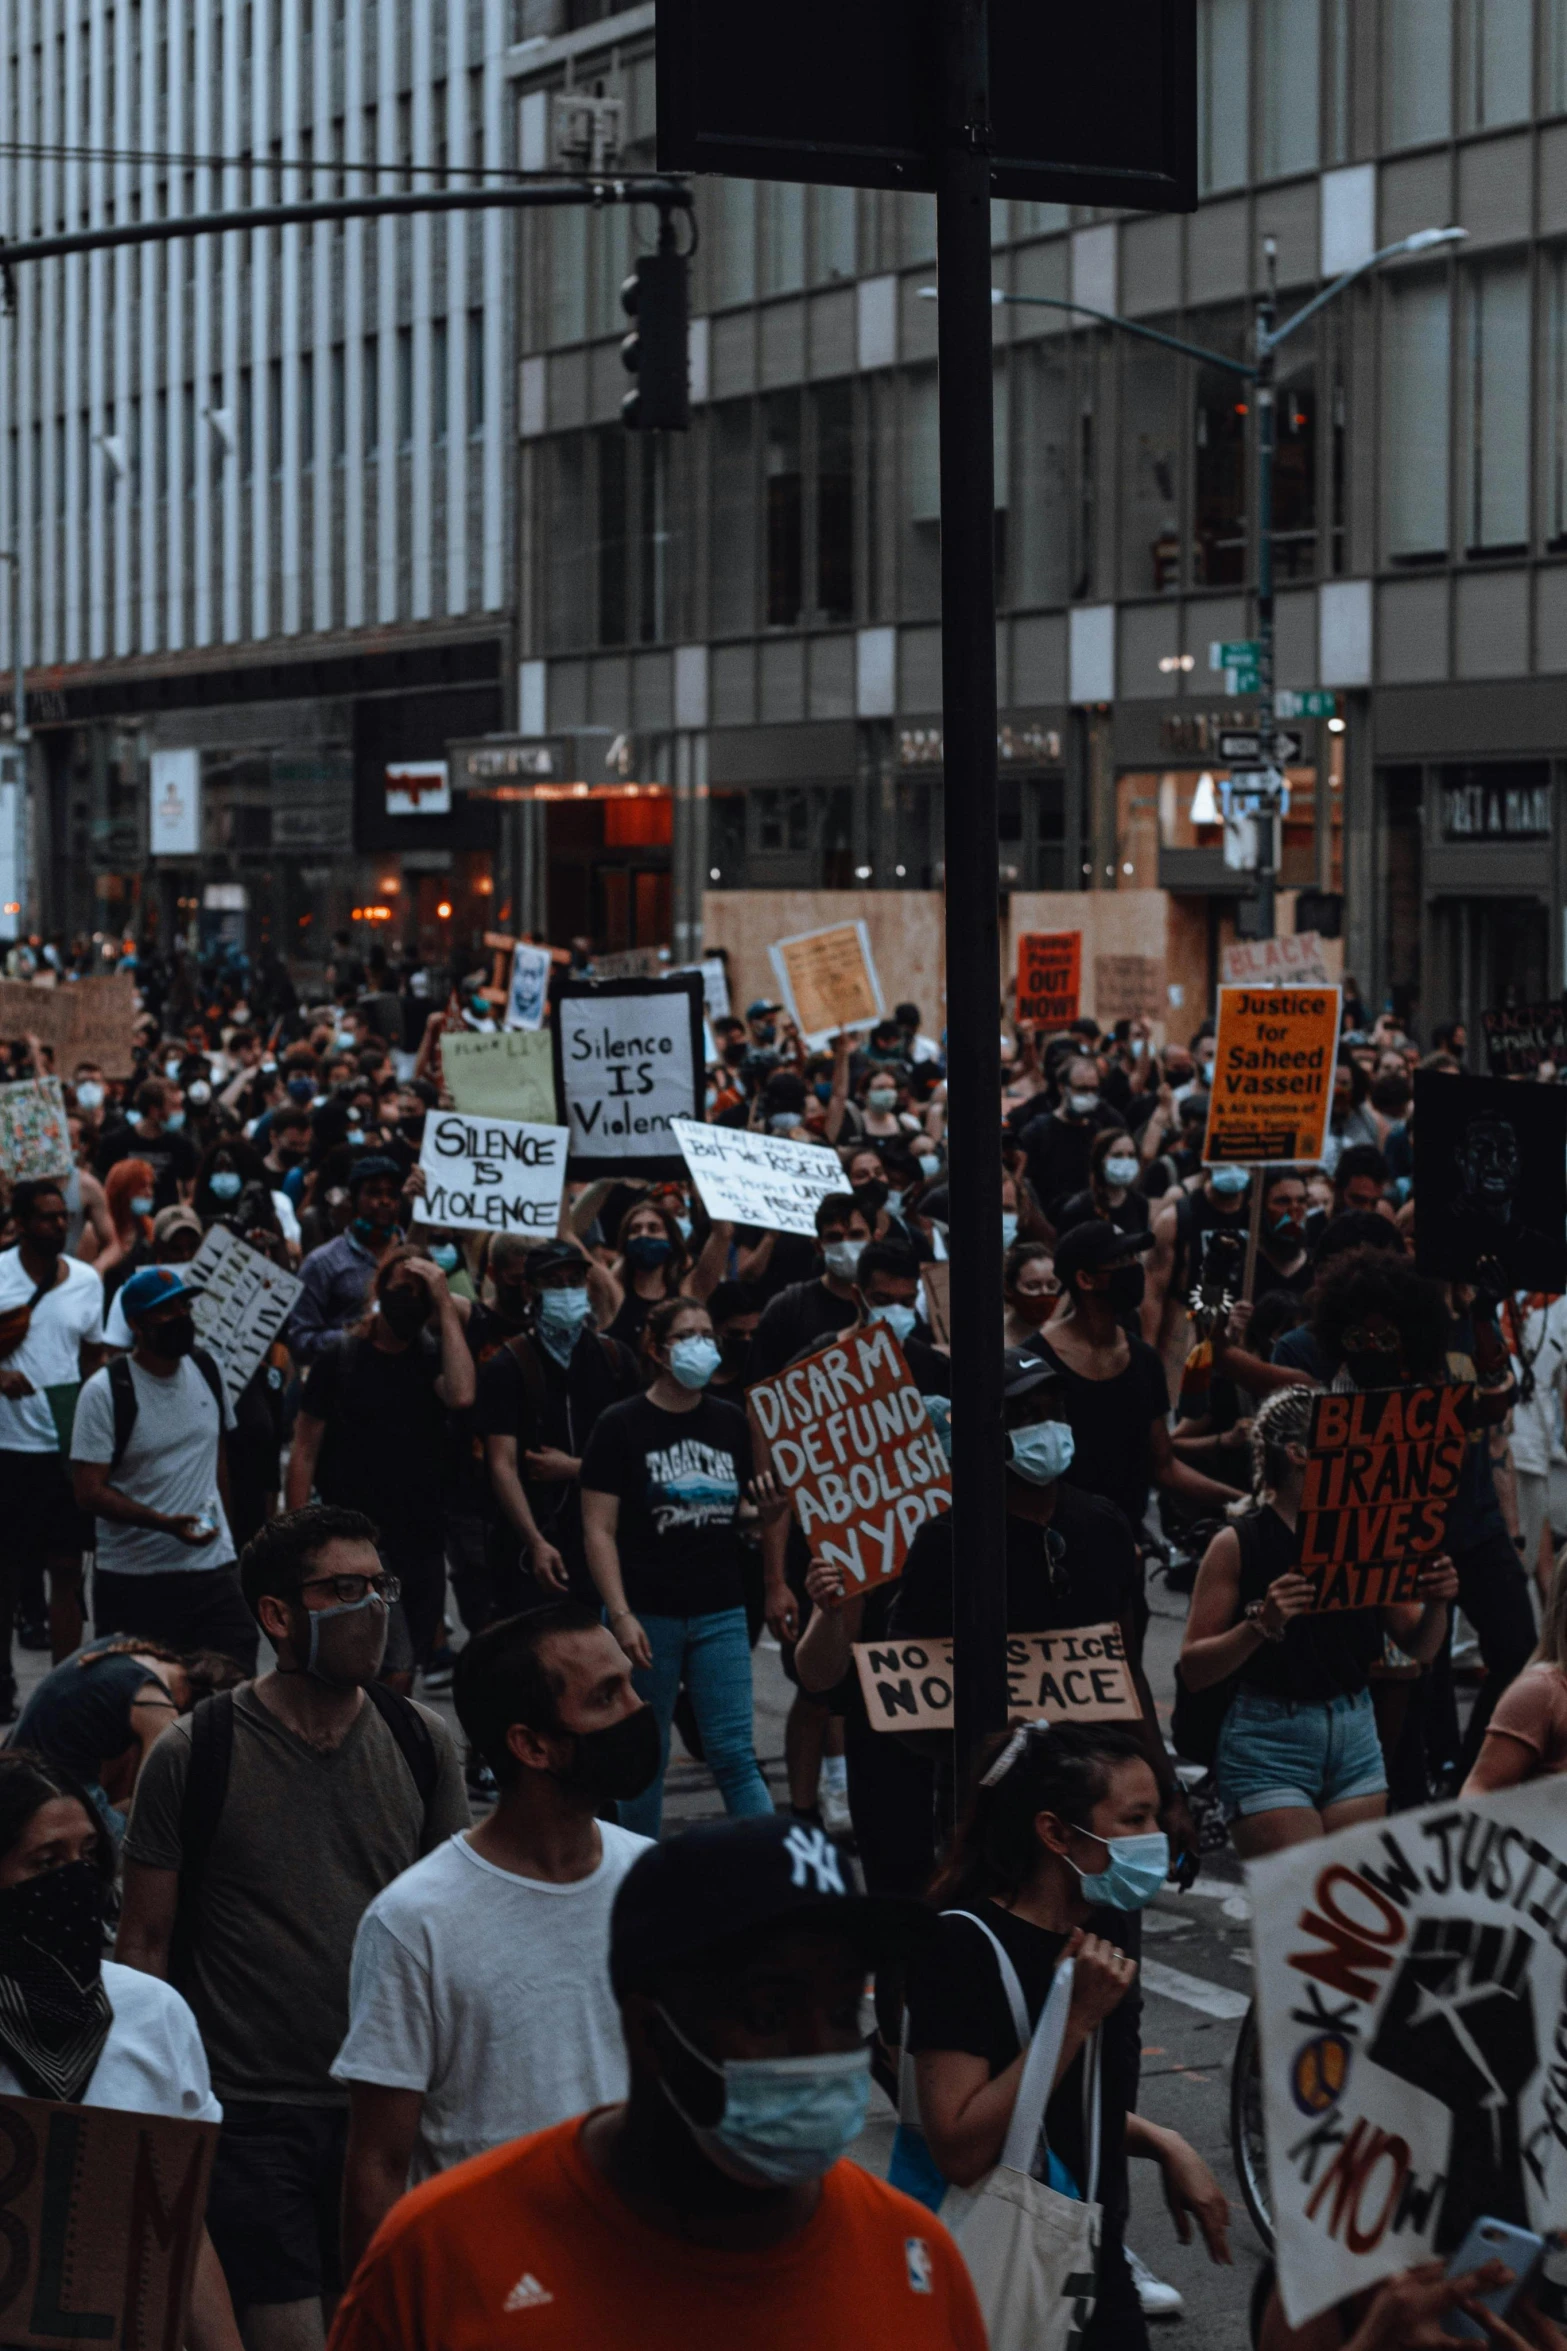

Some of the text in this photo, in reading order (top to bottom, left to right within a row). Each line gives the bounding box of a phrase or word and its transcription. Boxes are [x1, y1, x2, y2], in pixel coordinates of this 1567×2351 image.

[1029, 969, 1070, 993] OUT
[1237, 994, 1326, 1016] Justice
[571, 1028, 673, 1060] Silence
[1256, 1023, 1289, 1042] for
[1228, 1045, 1324, 1070] Saheed
[606, 1062, 654, 1096] IS
[1225, 1073, 1322, 1095] Vassell
[435, 1117, 557, 1167] SILENCE
[472, 1161, 503, 1186] IS
[816, 1162, 843, 1184] UP
[424, 1186, 559, 1228] VIOLENCE
[749, 1329, 902, 1440] DISARM
[771, 1385, 926, 1488] DEFUND
[1315, 1384, 1471, 1448] BLACK
[794, 1432, 951, 1536] ABOLISH
[1310, 1438, 1461, 1508] TRANS
[1301, 1500, 1449, 1564] LIVES
[867, 1635, 1127, 1674] NO STICE
[876, 1669, 1126, 1718] NO EACE
[781, 1824, 847, 1898] NY
[1286, 2107, 1448, 2256] KNOW
